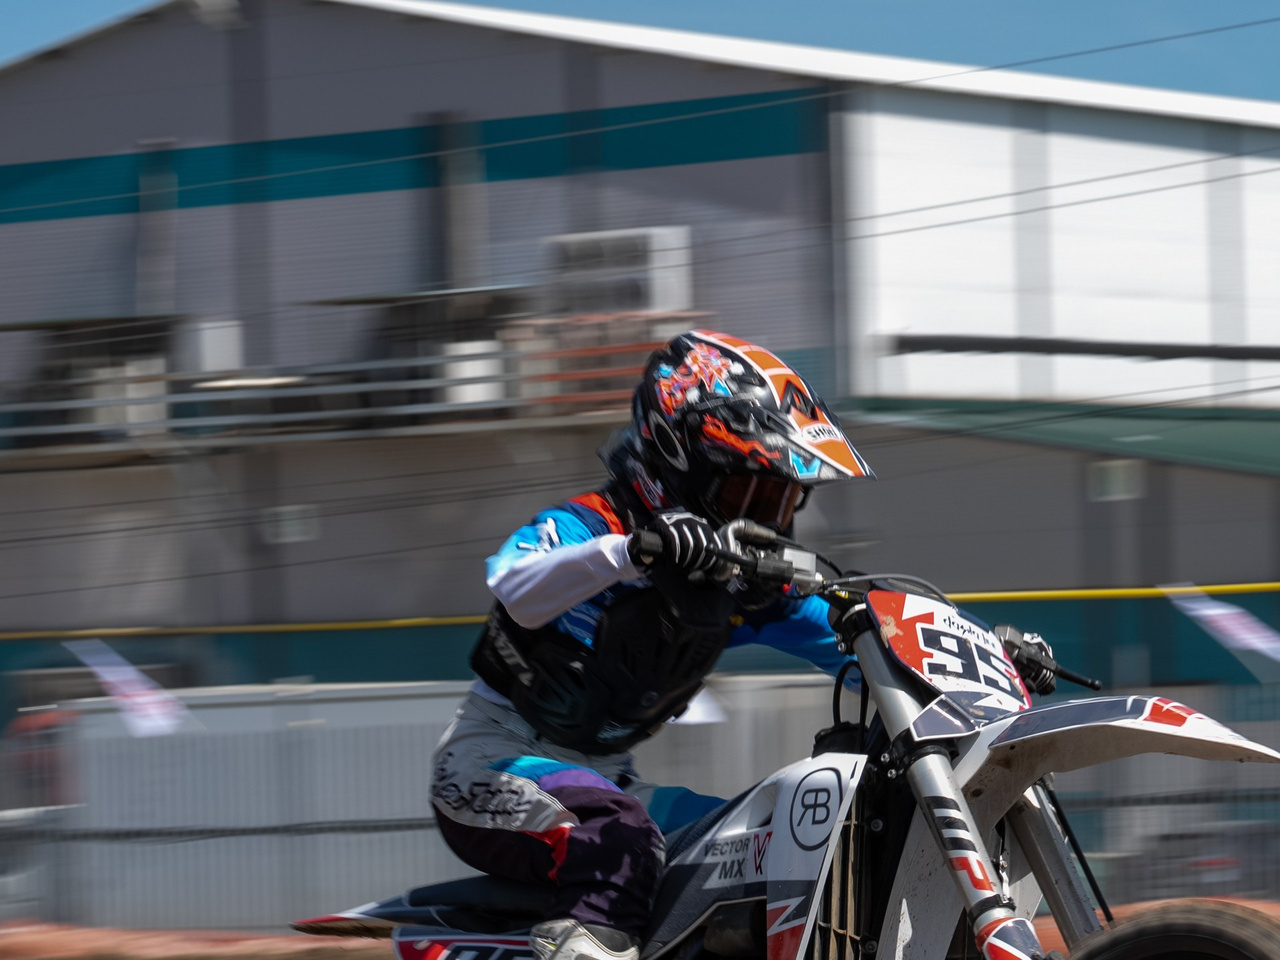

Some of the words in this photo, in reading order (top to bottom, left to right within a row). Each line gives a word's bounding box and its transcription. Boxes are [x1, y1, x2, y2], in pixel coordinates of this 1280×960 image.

[920, 627, 1025, 706] 95
[703, 838, 750, 858] VECTOR
[717, 860, 748, 880] MX
